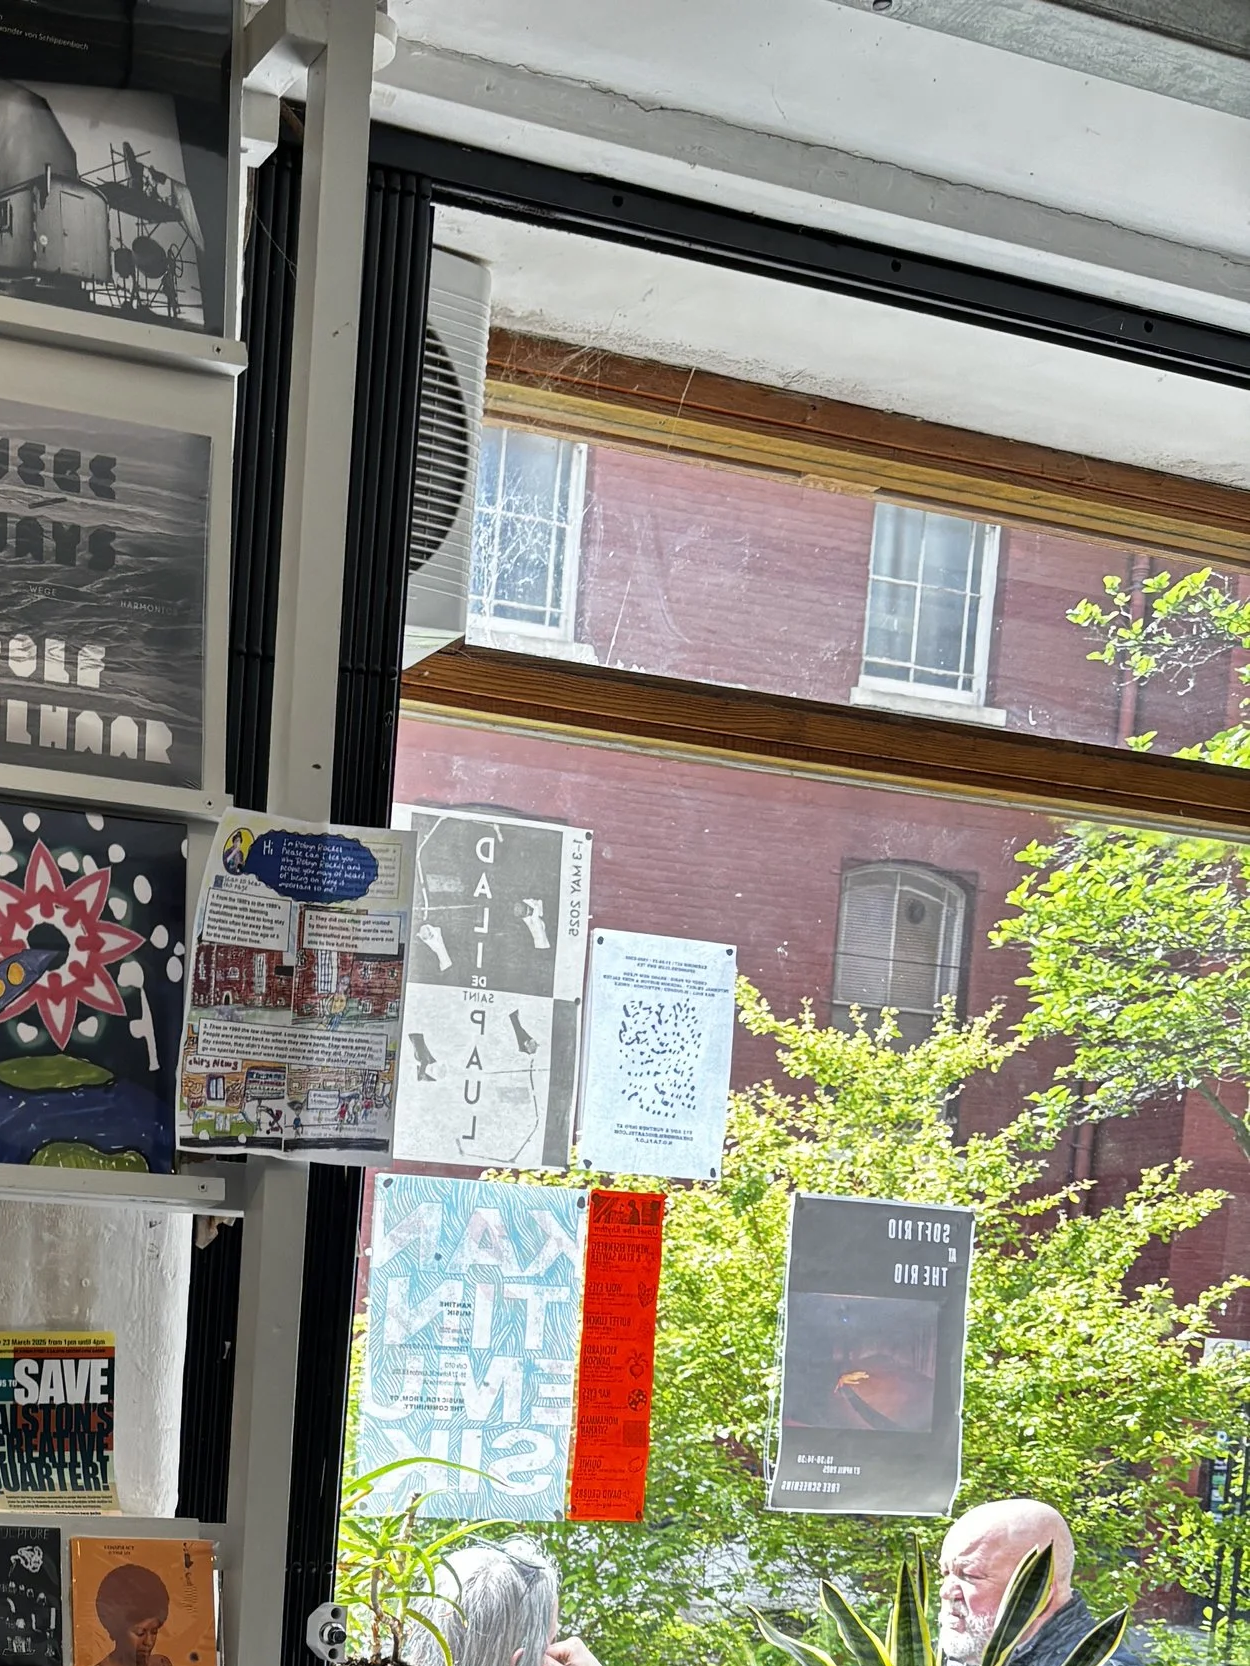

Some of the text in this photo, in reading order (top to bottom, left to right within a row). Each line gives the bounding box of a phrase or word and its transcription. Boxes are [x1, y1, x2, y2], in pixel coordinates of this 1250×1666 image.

[39, 34, 89, 50] Schlippenbach
[29, 585, 57, 597] WEGE
[302, 868, 314, 876] you
[64, 1339, 77, 1347] 1pm
[93, 1339, 105, 1347] 4pm
[14, 1358, 108, 1405] SAVE
